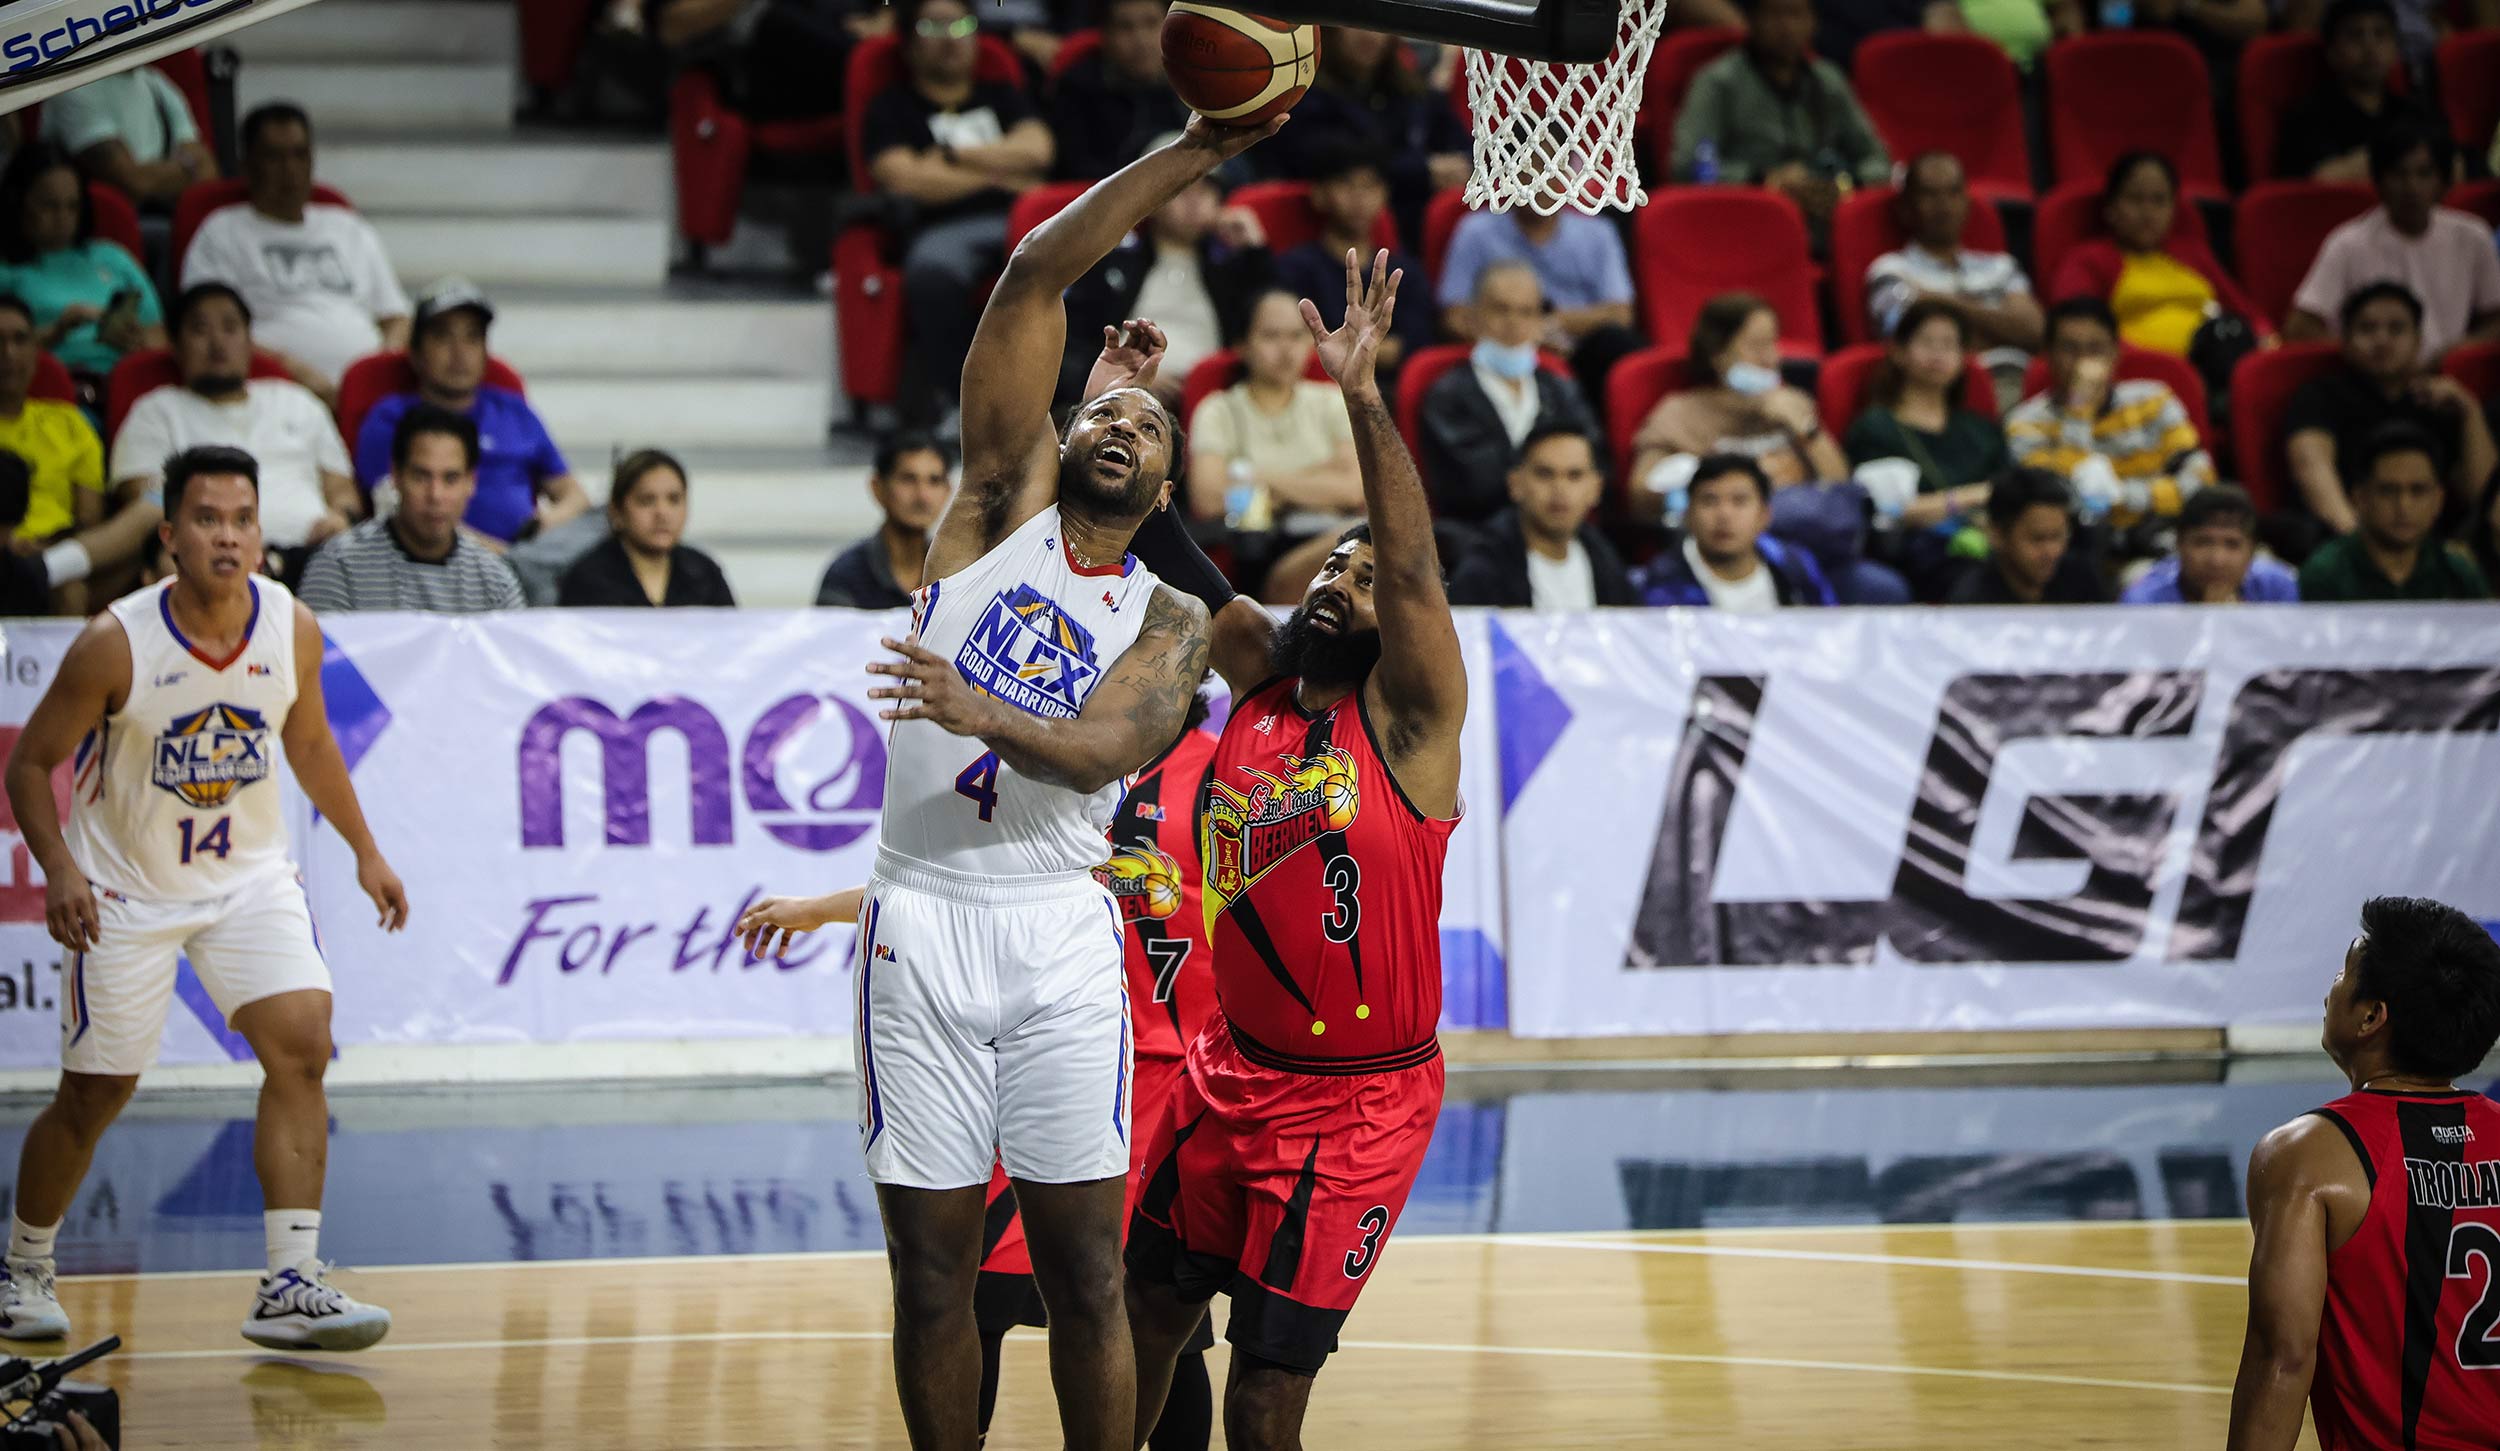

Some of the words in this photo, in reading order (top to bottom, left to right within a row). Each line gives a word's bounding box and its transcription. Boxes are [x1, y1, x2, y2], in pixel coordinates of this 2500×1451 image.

[958, 643, 995, 683] ROAD
[993, 671, 1078, 718] WARRIORS
[972, 600, 1094, 710] NLEX
[160, 731, 264, 765] NLEX
[954, 750, 999, 823] 4
[1136, 802, 1167, 821] PBA
[177, 816, 231, 866] 14
[1251, 803, 1330, 873] BEERMEN
[1321, 854, 1361, 944] 3
[497, 894, 656, 986] For
[875, 943, 897, 964] PBA
[1147, 938, 1193, 1004] 7
[2441, 1125, 2474, 1138] DELTA
[1343, 1205, 1389, 1280] 3
